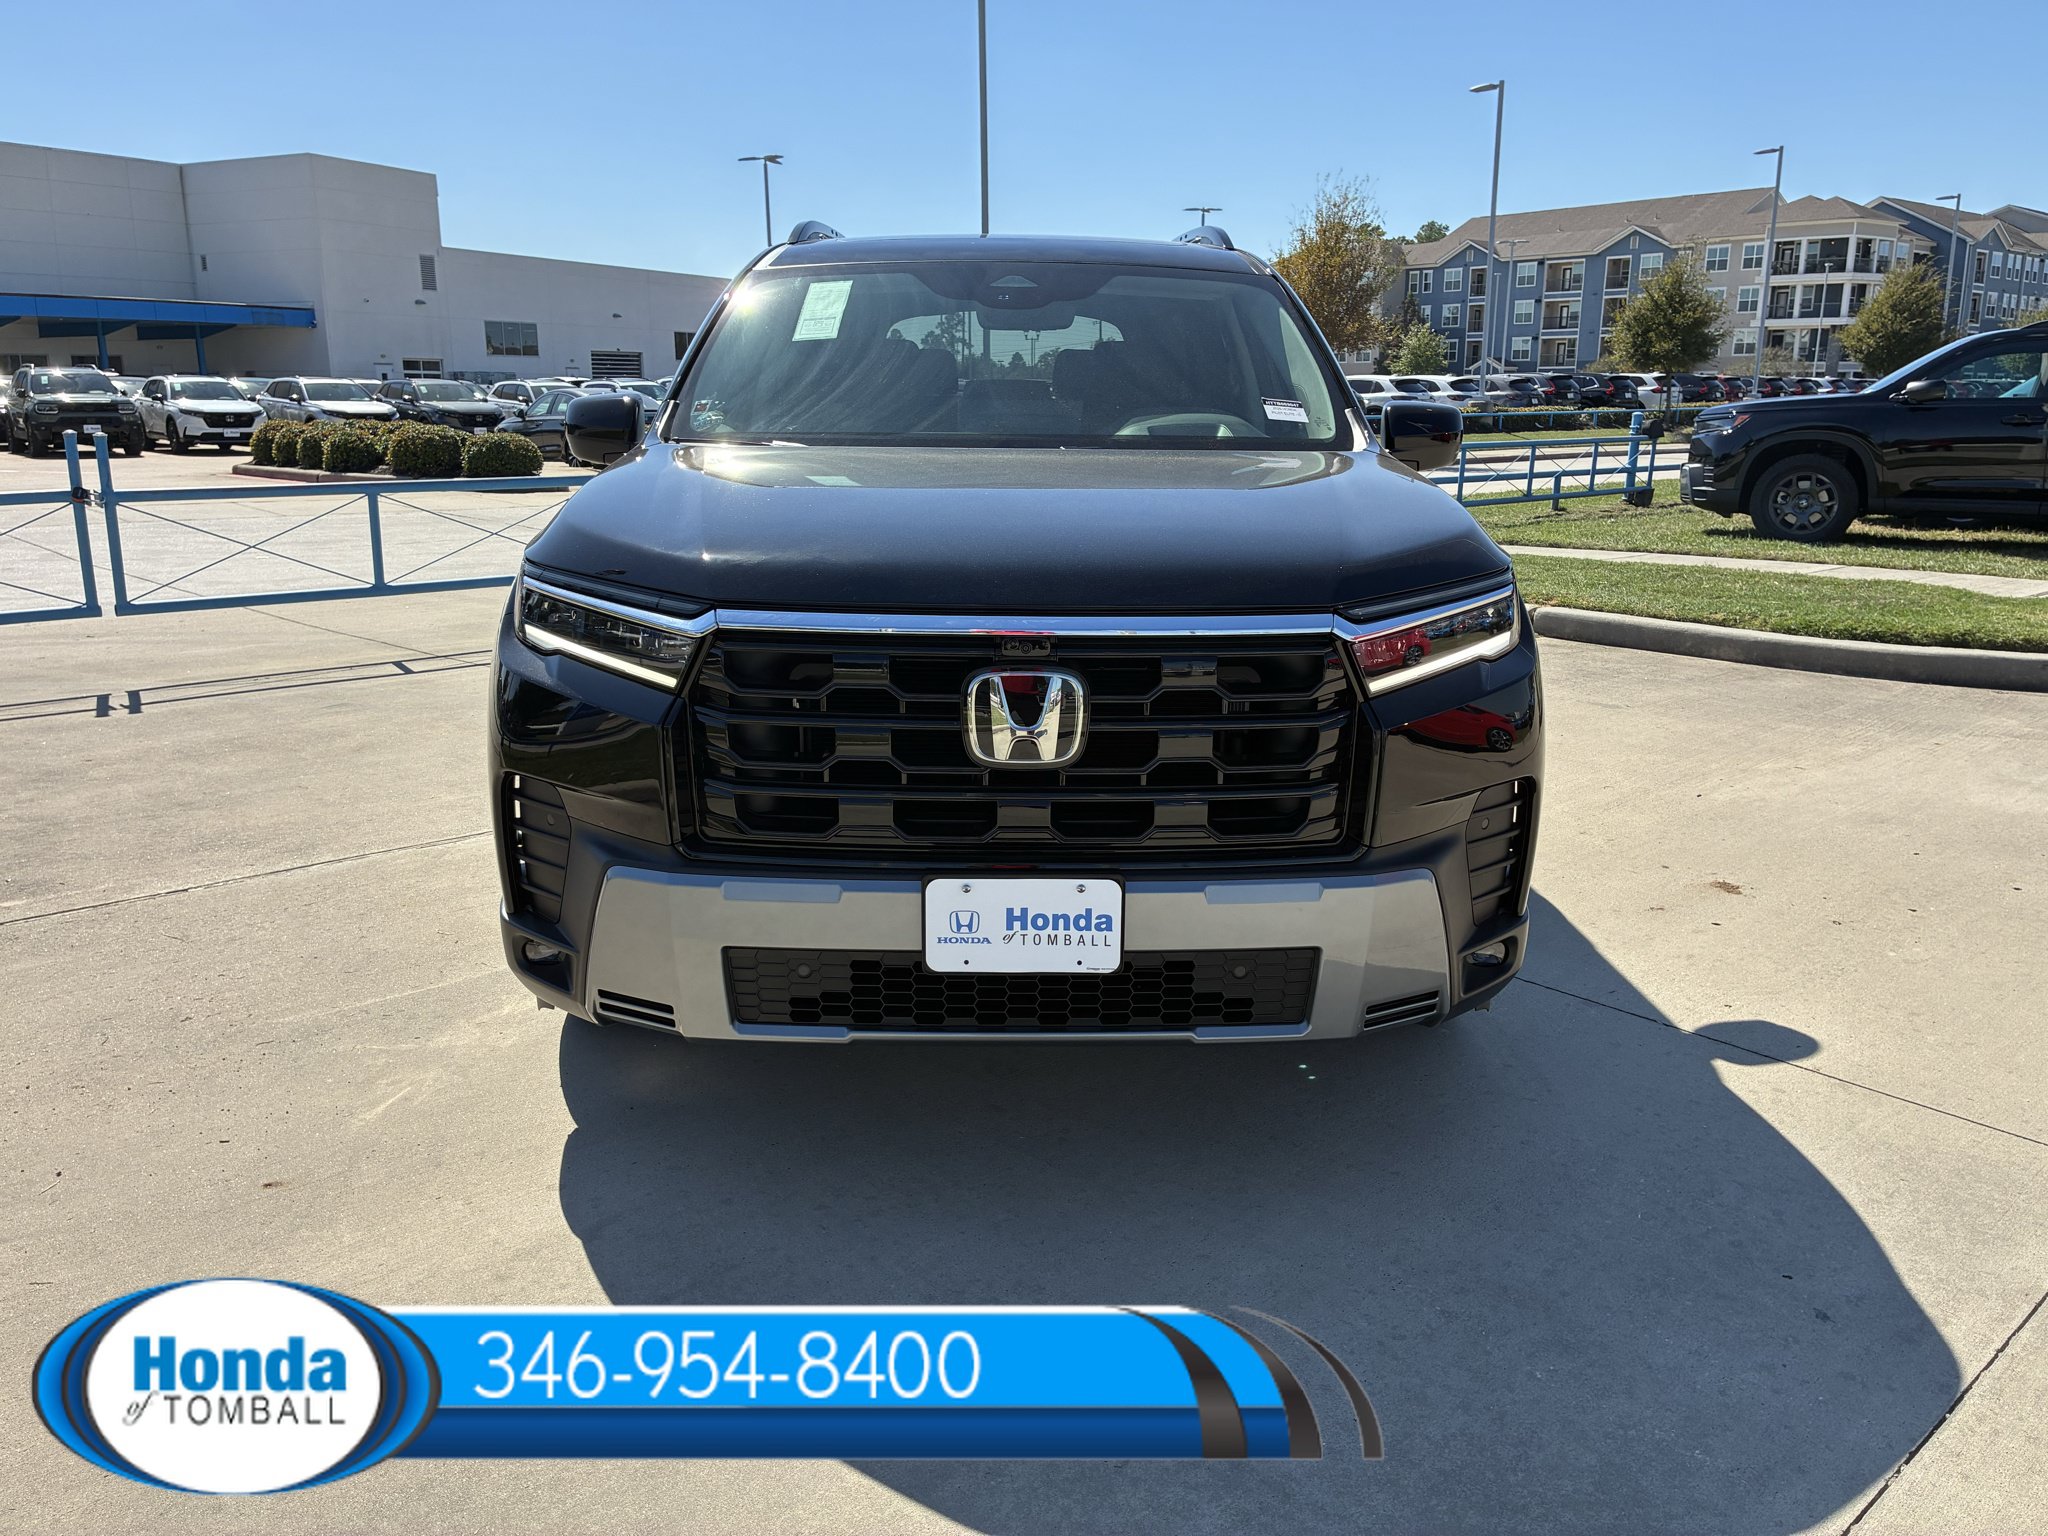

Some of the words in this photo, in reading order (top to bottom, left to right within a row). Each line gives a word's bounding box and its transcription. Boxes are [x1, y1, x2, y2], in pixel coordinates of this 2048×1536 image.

[1005, 907, 1113, 932] Honda
[936, 936, 993, 945] HONDA
[1002, 930, 1019, 945] of
[1020, 933, 1112, 947] TOMBALL
